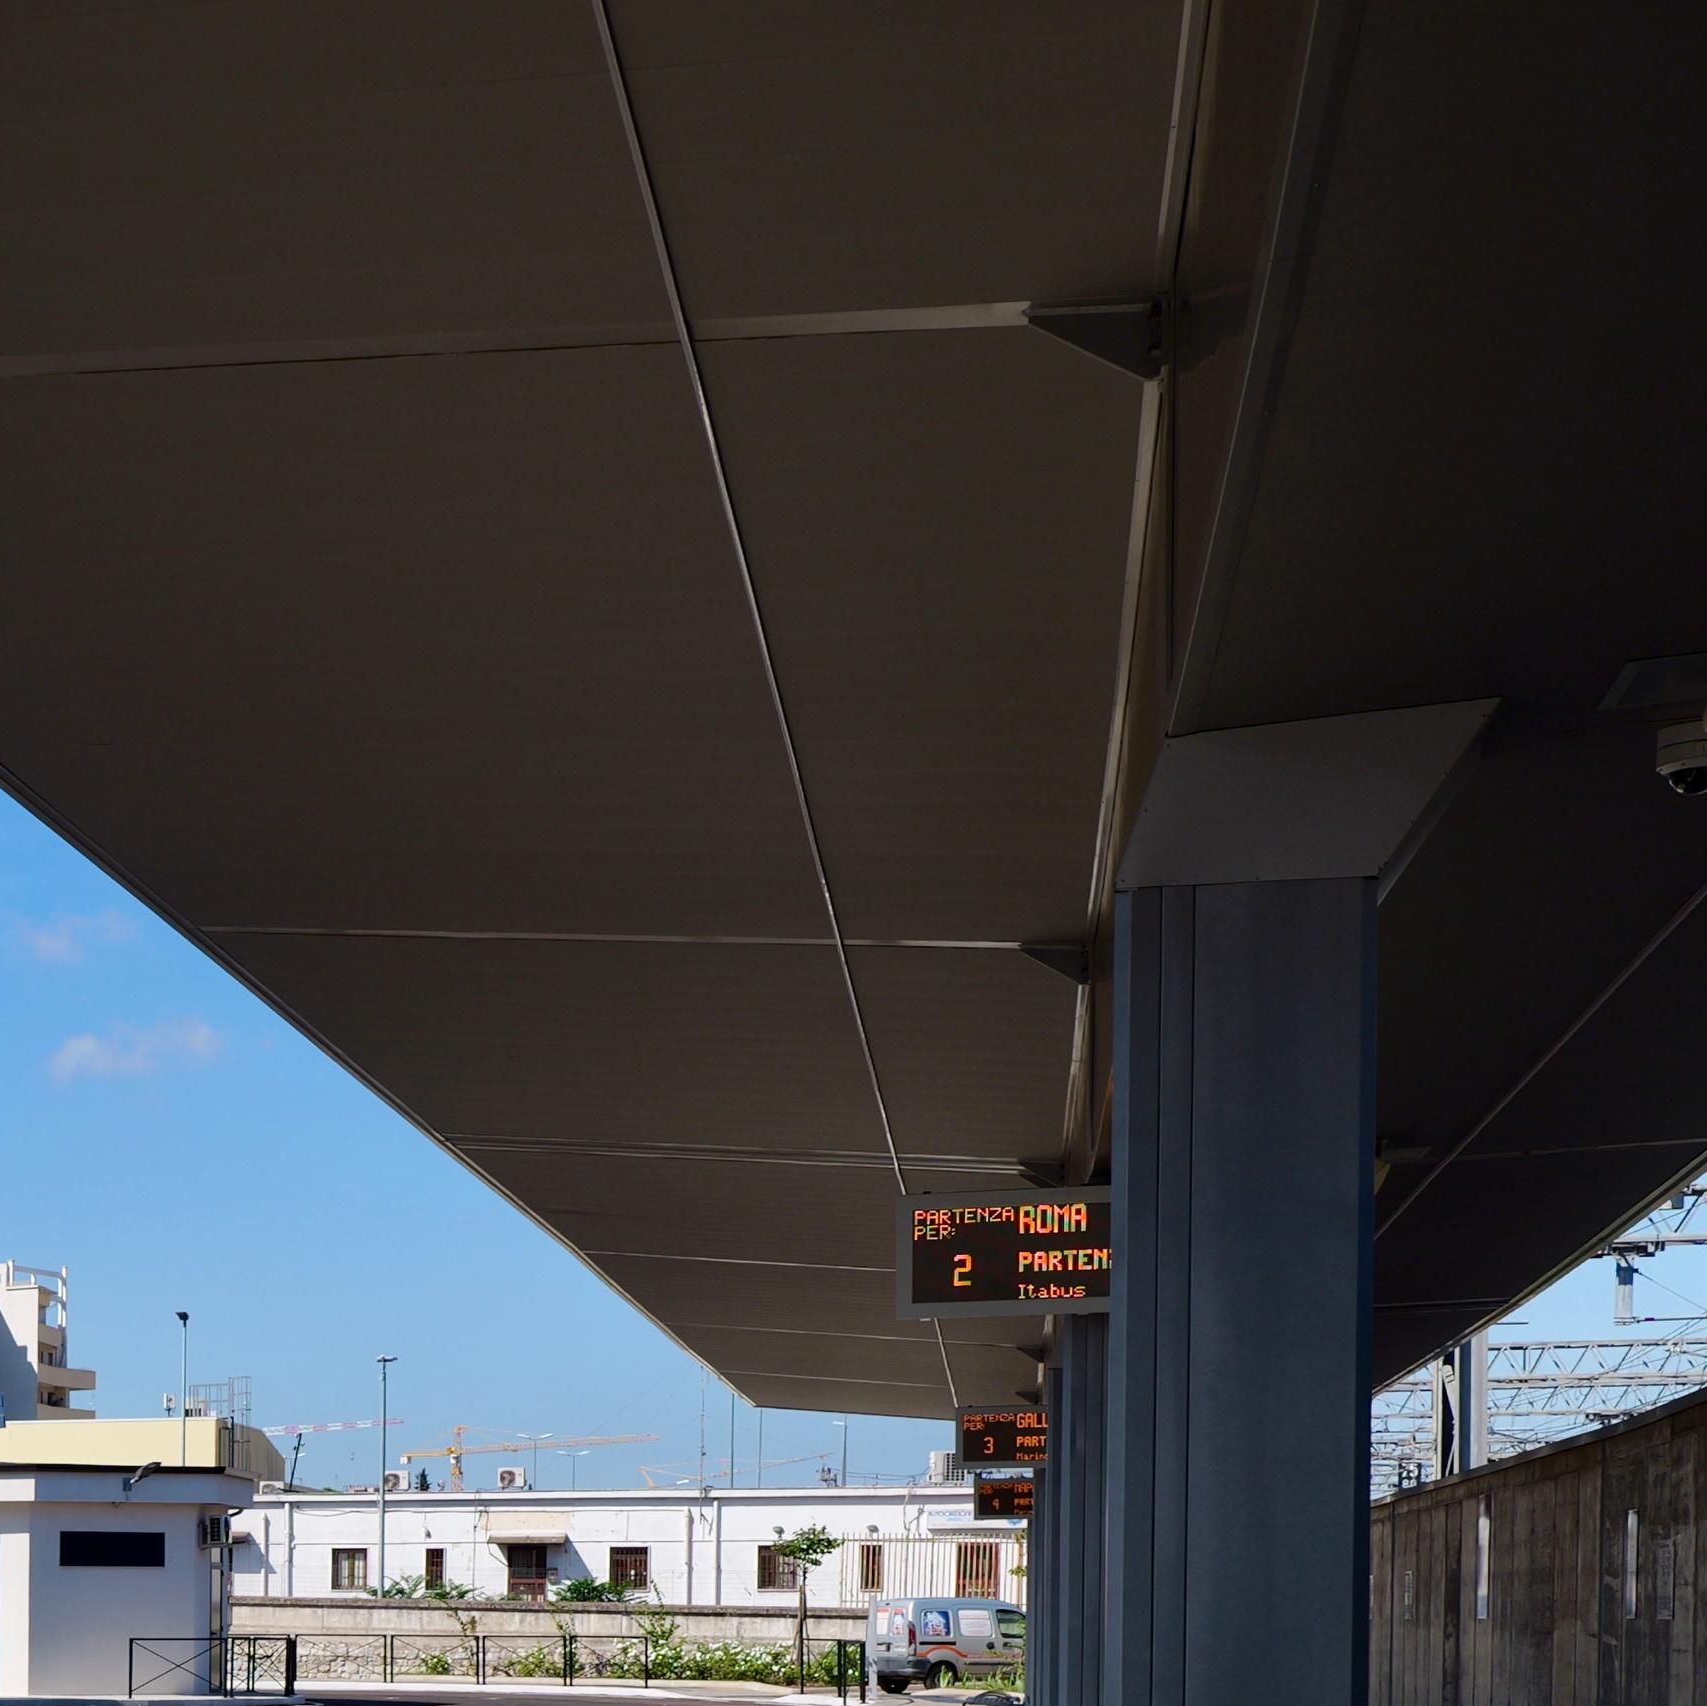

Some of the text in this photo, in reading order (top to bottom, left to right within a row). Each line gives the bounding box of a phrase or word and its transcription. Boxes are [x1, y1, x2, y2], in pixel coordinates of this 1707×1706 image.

[913, 1206, 1015, 1225] PARTENZA
[1018, 1203, 1088, 1235] ROMA
[913, 1225, 956, 1241] PER:
[953, 1254, 972, 1287] 2
[1018, 1283, 1087, 1299] Itabus
[983, 1436, 994, 1454] 3
